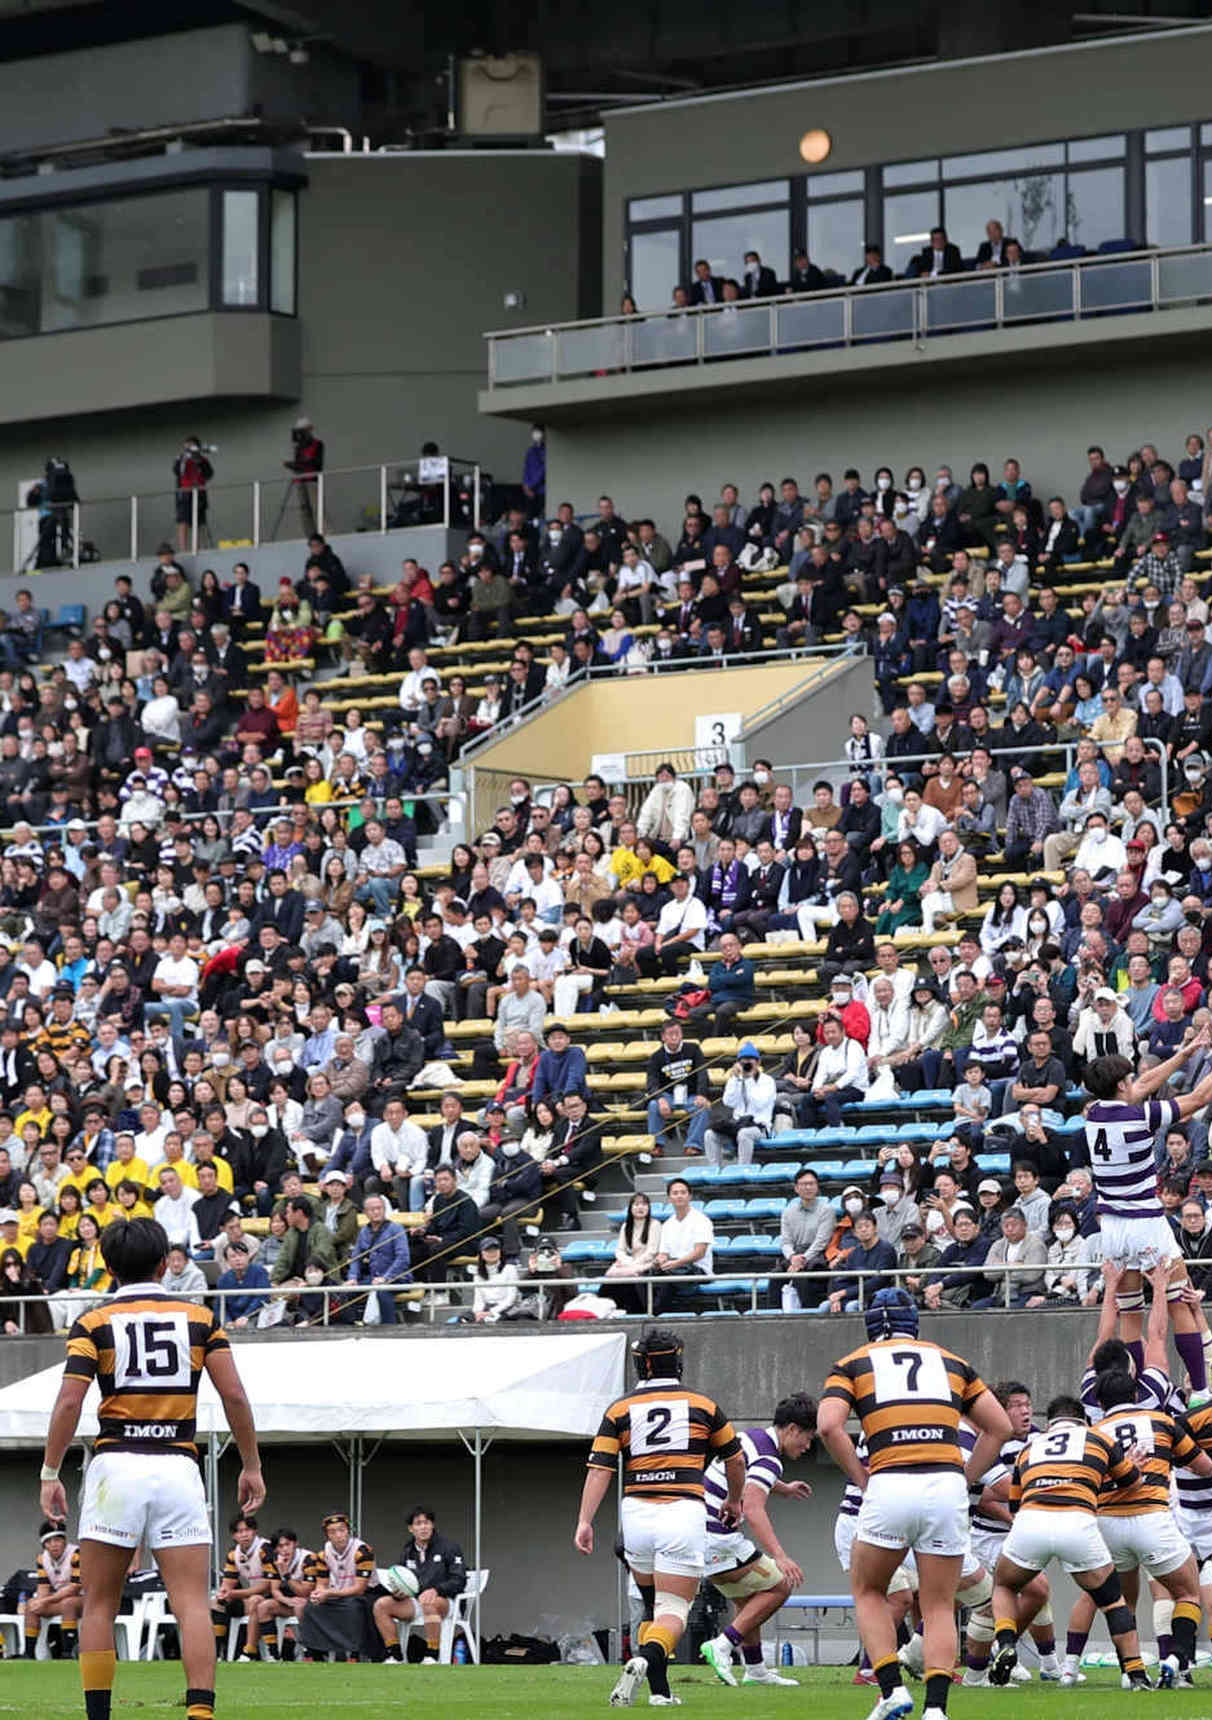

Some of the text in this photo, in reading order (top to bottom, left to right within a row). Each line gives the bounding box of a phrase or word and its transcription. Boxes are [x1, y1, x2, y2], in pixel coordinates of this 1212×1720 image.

[712, 722, 725, 746] 3
[1094, 1128, 1112, 1162] 4
[125, 1321, 179, 1376] 15
[891, 1351, 922, 1392] 7
[123, 1425, 178, 1438] IMON
[646, 1407, 671, 1446] 2
[891, 1428, 944, 1442] IMON
[1115, 1423, 1138, 1452] 8
[1044, 1432, 1070, 1456] 3
